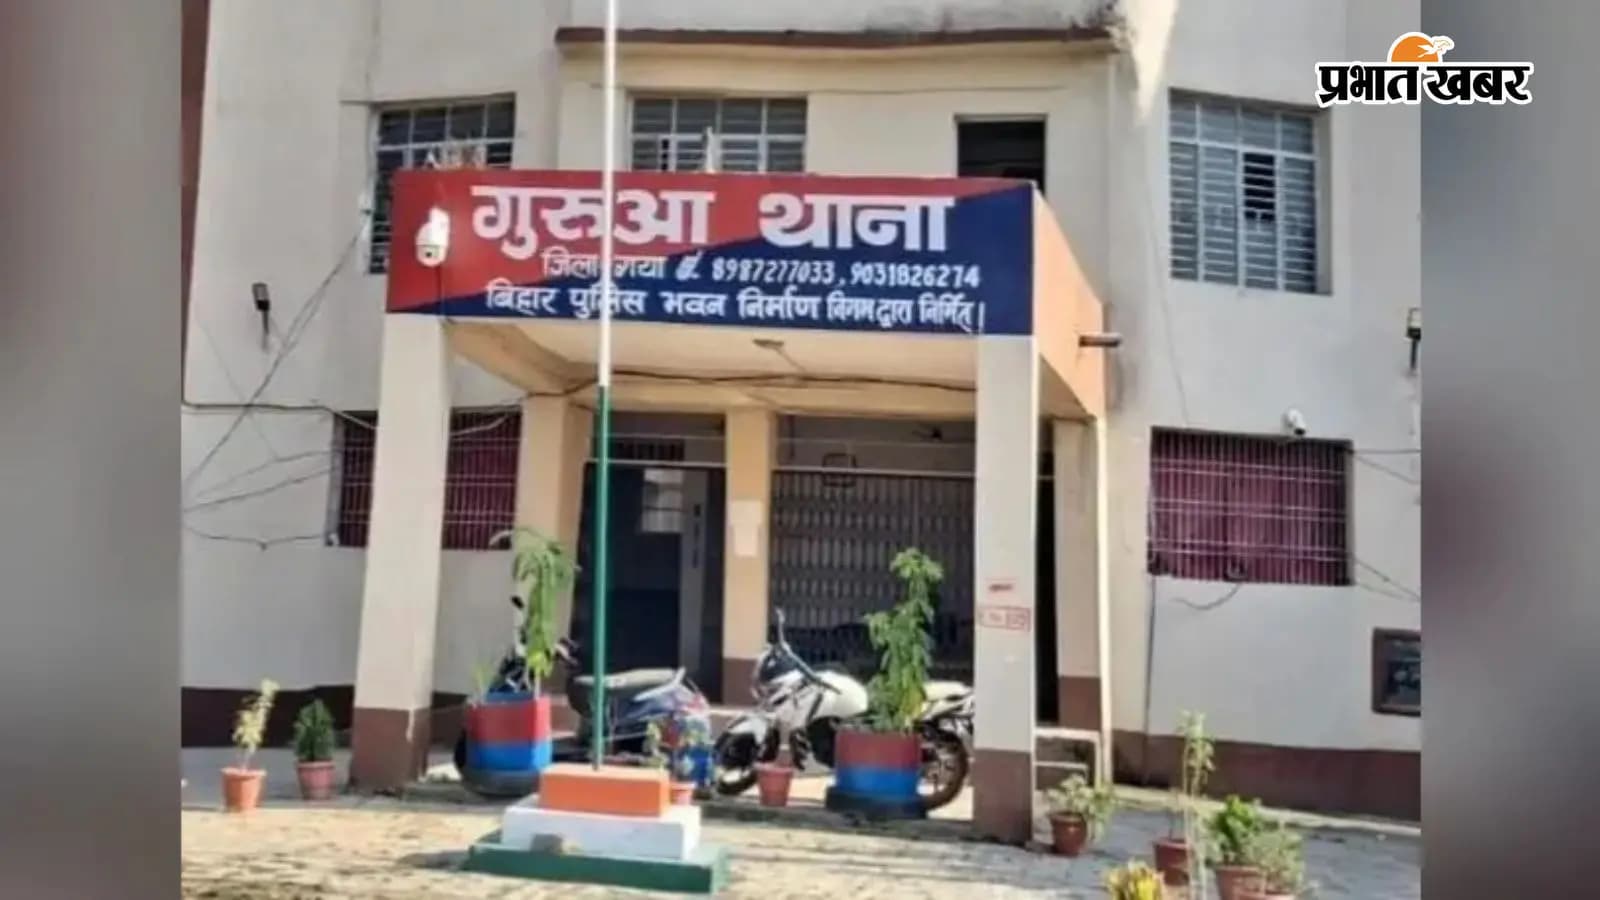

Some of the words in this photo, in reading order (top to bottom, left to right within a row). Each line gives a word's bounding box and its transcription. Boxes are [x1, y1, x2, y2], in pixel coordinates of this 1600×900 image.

[470, 185, 716, 260] गुरुआ
[758, 192, 956, 251] थाना
[541, 247, 599, 279] जिला
[850, 261, 981, 288] 9031826274
[484, 280, 560, 316] बिहार
[659, 291, 727, 317] भवन
[736, 284, 821, 321] निर्माण
